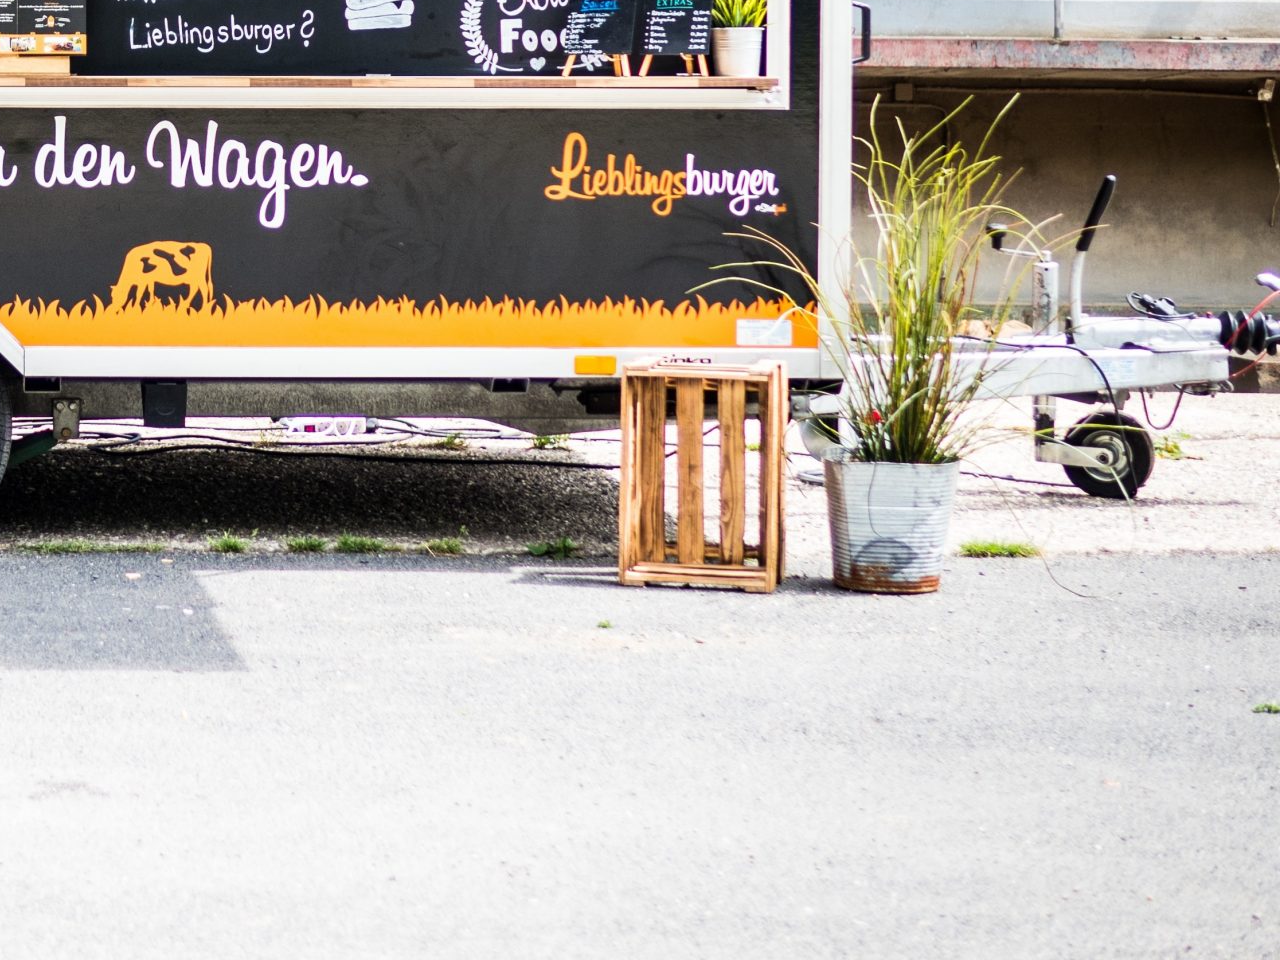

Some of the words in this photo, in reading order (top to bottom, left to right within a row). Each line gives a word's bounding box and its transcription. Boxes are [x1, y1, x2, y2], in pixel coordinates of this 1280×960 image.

[34, 115, 136, 189] den
[146, 119, 369, 229] Wagen.
[543, 131, 780, 217] Lieblingsburger
